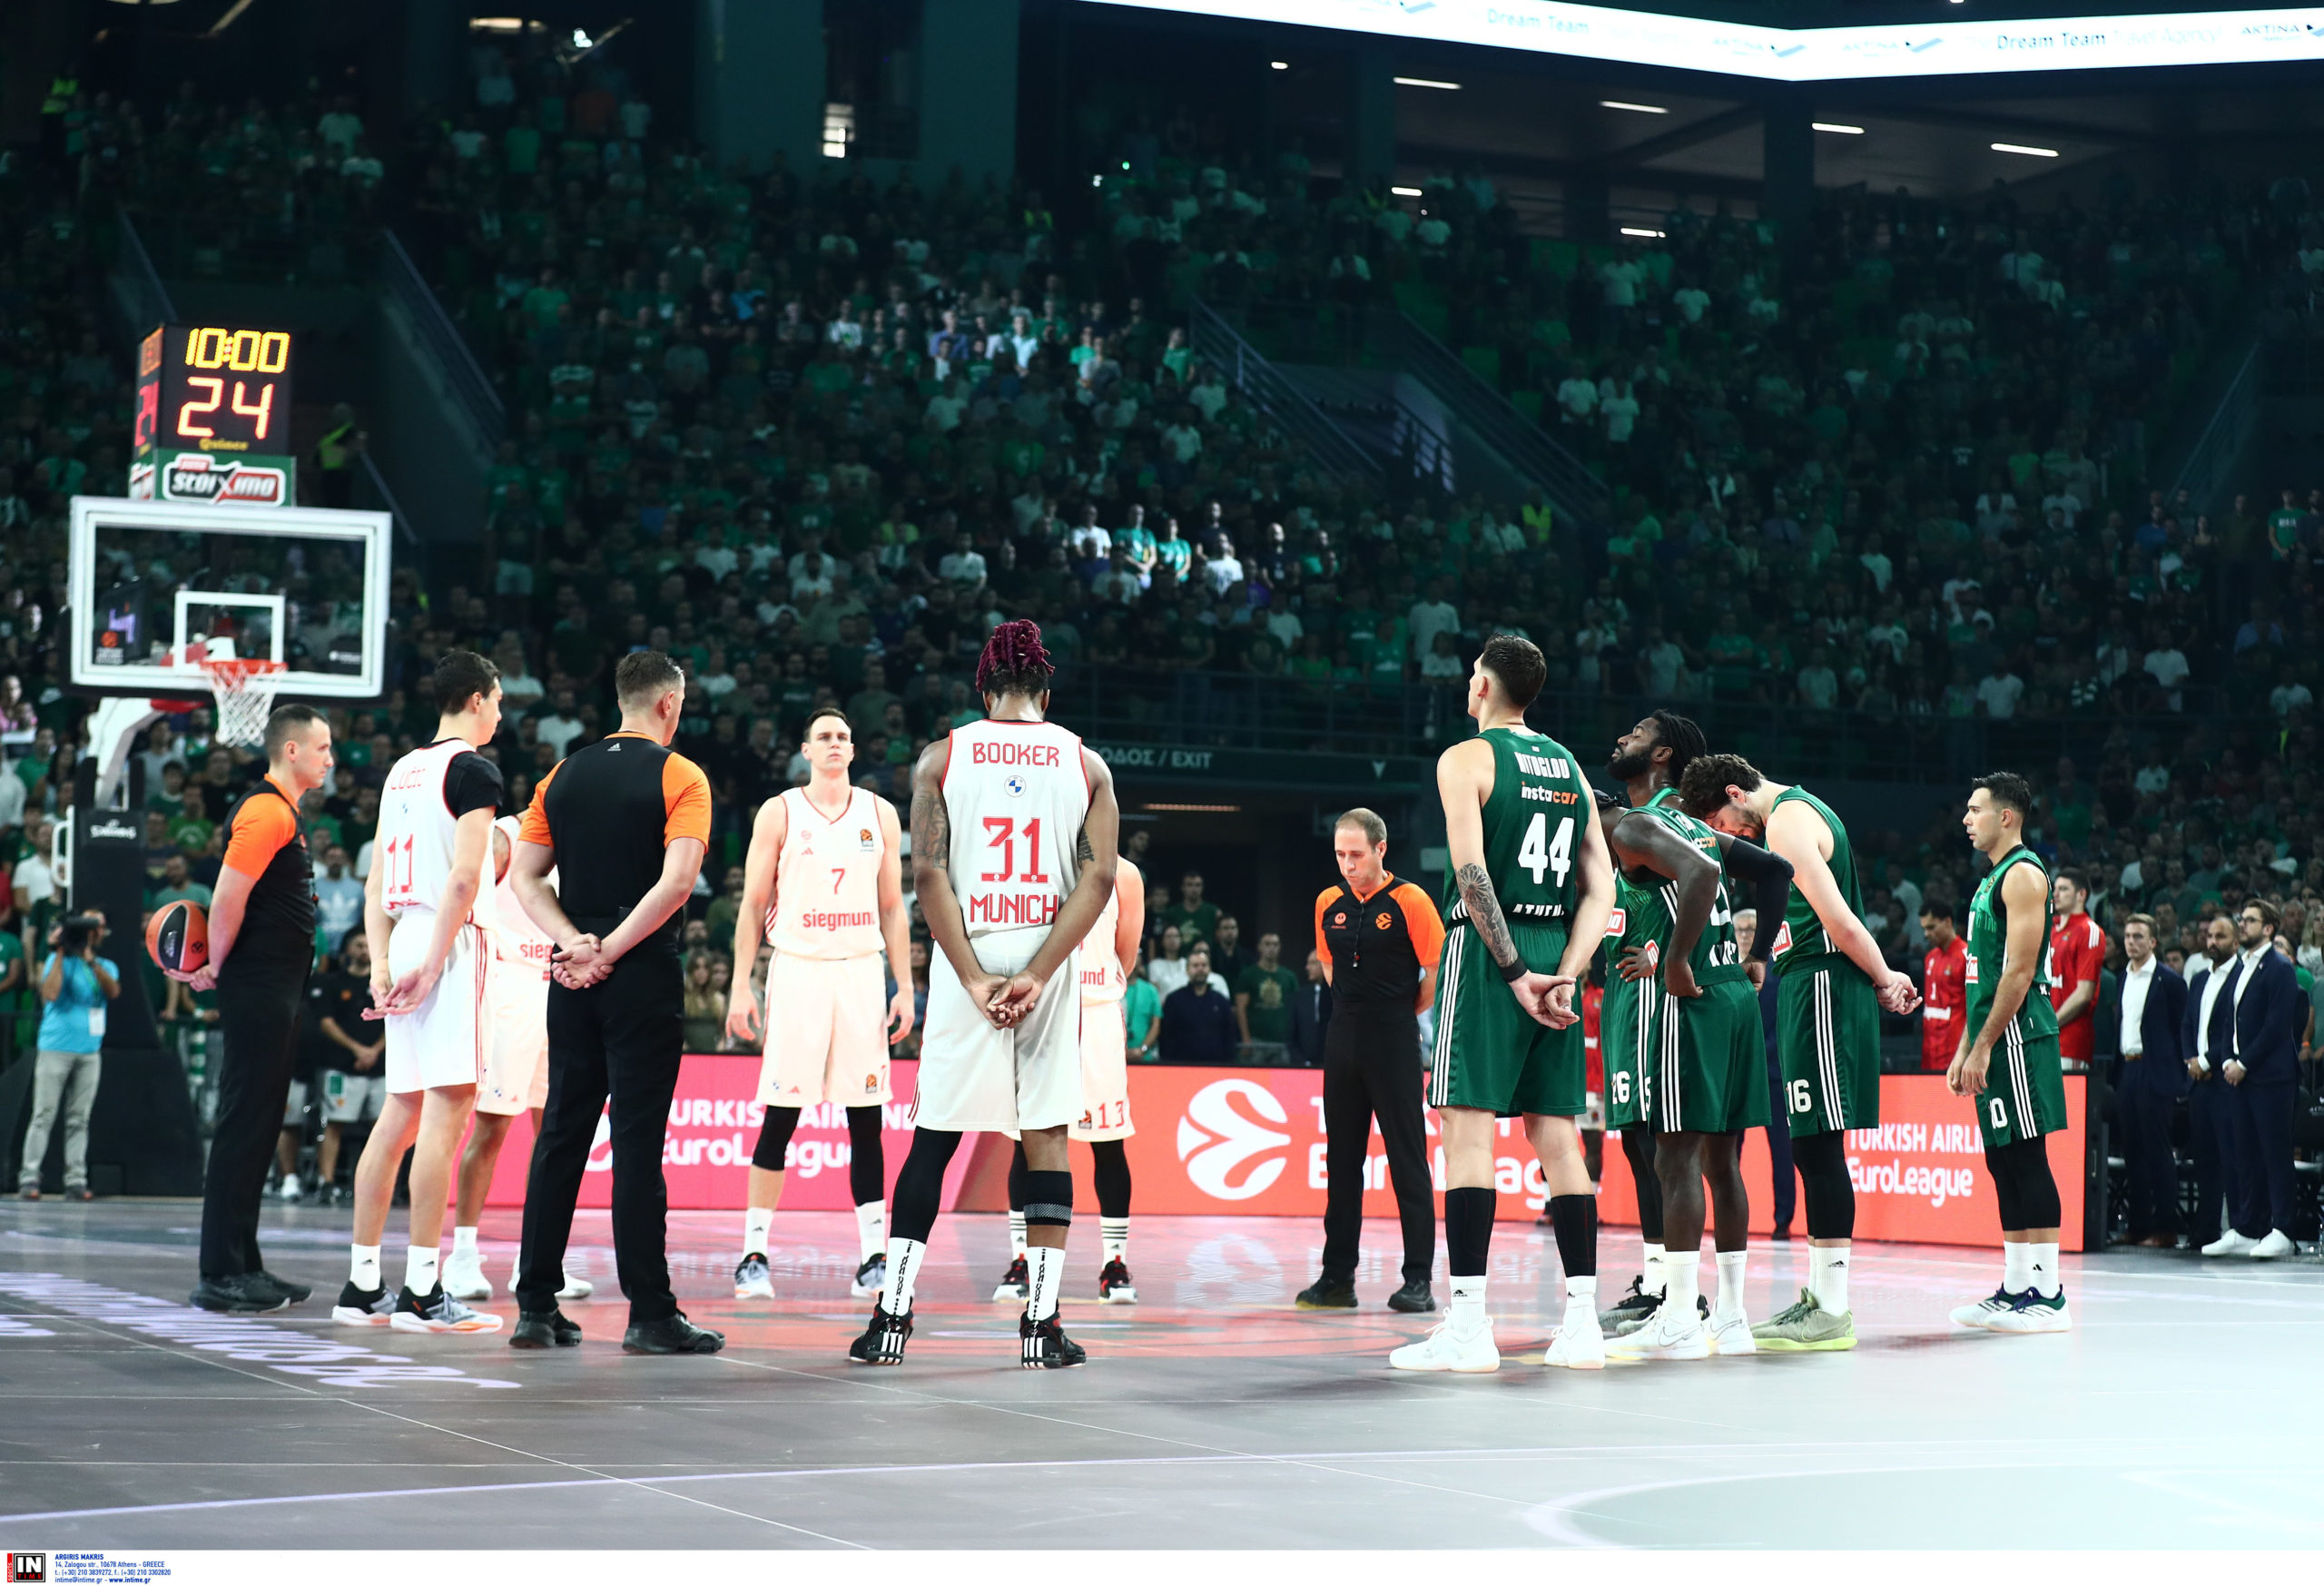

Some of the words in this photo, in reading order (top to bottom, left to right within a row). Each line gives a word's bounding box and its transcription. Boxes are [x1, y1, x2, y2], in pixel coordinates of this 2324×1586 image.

[1486, 8, 1541, 30] Dream
[1548, 15, 1590, 34] Team
[1996, 34, 2054, 51] Dream
[2060, 31, 2107, 48] Team
[185, 328, 290, 374] 10:00
[177, 376, 274, 439] 24
[972, 742, 1060, 768] BOOKER
[1171, 751, 1213, 769] EXIT
[1521, 781, 1579, 805] instacar
[387, 833, 414, 895] 11
[980, 816, 1049, 884] 31
[1517, 812, 1575, 888] 44
[831, 868, 846, 895] 7
[970, 892, 1059, 925] MUNICH
[519, 939, 554, 964] sieg
[1846, 1156, 1974, 1208] EuroLeague
